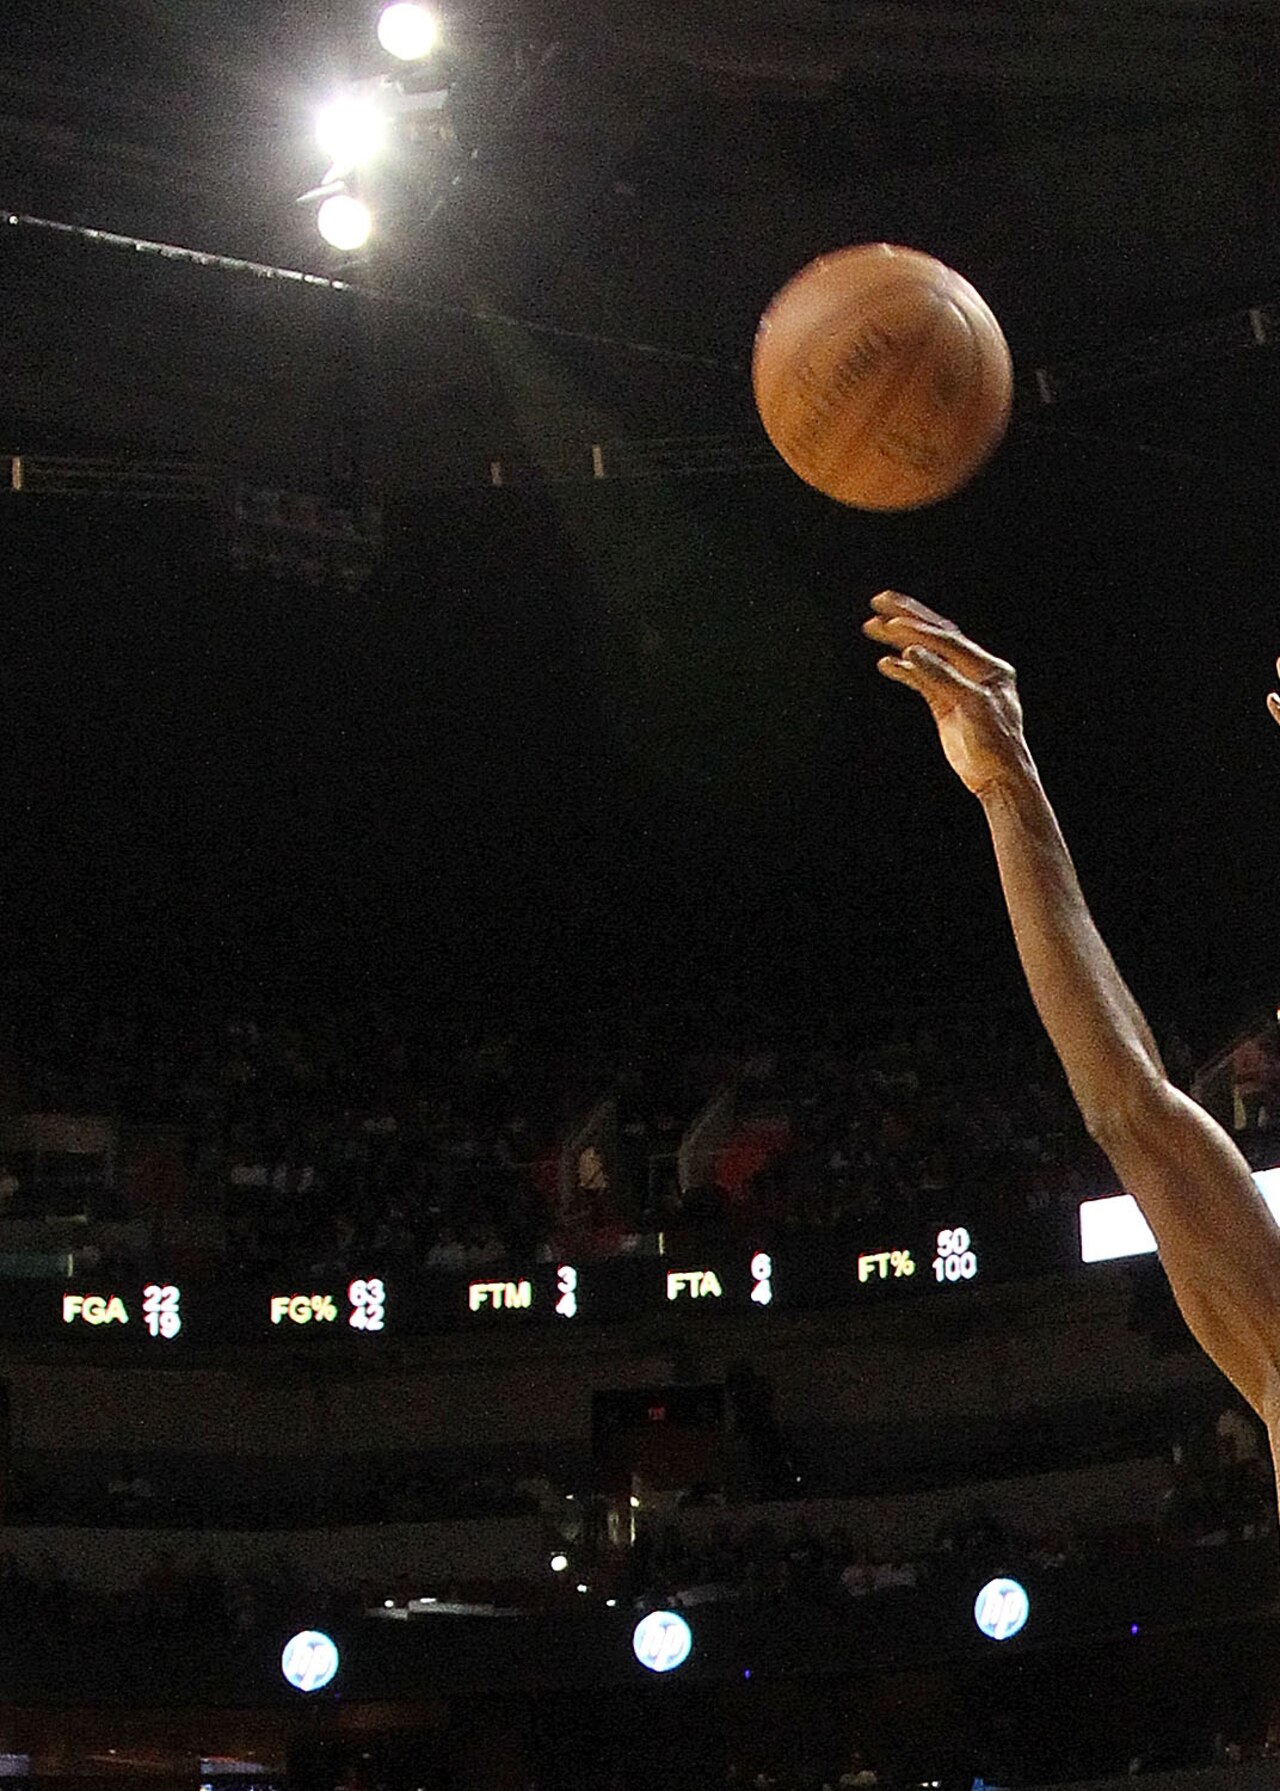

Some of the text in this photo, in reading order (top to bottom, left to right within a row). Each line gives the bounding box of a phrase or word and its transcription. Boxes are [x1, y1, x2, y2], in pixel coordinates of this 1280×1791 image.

[935, 1227, 970, 1256] 50
[556, 1265, 577, 1293] 3
[750, 1252, 772, 1281] 6
[858, 1250, 915, 1283] FT%
[932, 1251, 977, 1282] 100
[143, 1286, 180, 1312] 22
[469, 1281, 532, 1312] FTM
[667, 1271, 722, 1301] FTA
[750, 1279, 772, 1306] 4
[63, 1296, 129, 1325] FGA
[271, 1295, 337, 1325] FG%
[349, 1304, 385, 1331] 42
[555, 1291, 577, 1318] 4
[145, 1310, 181, 1339] 19
